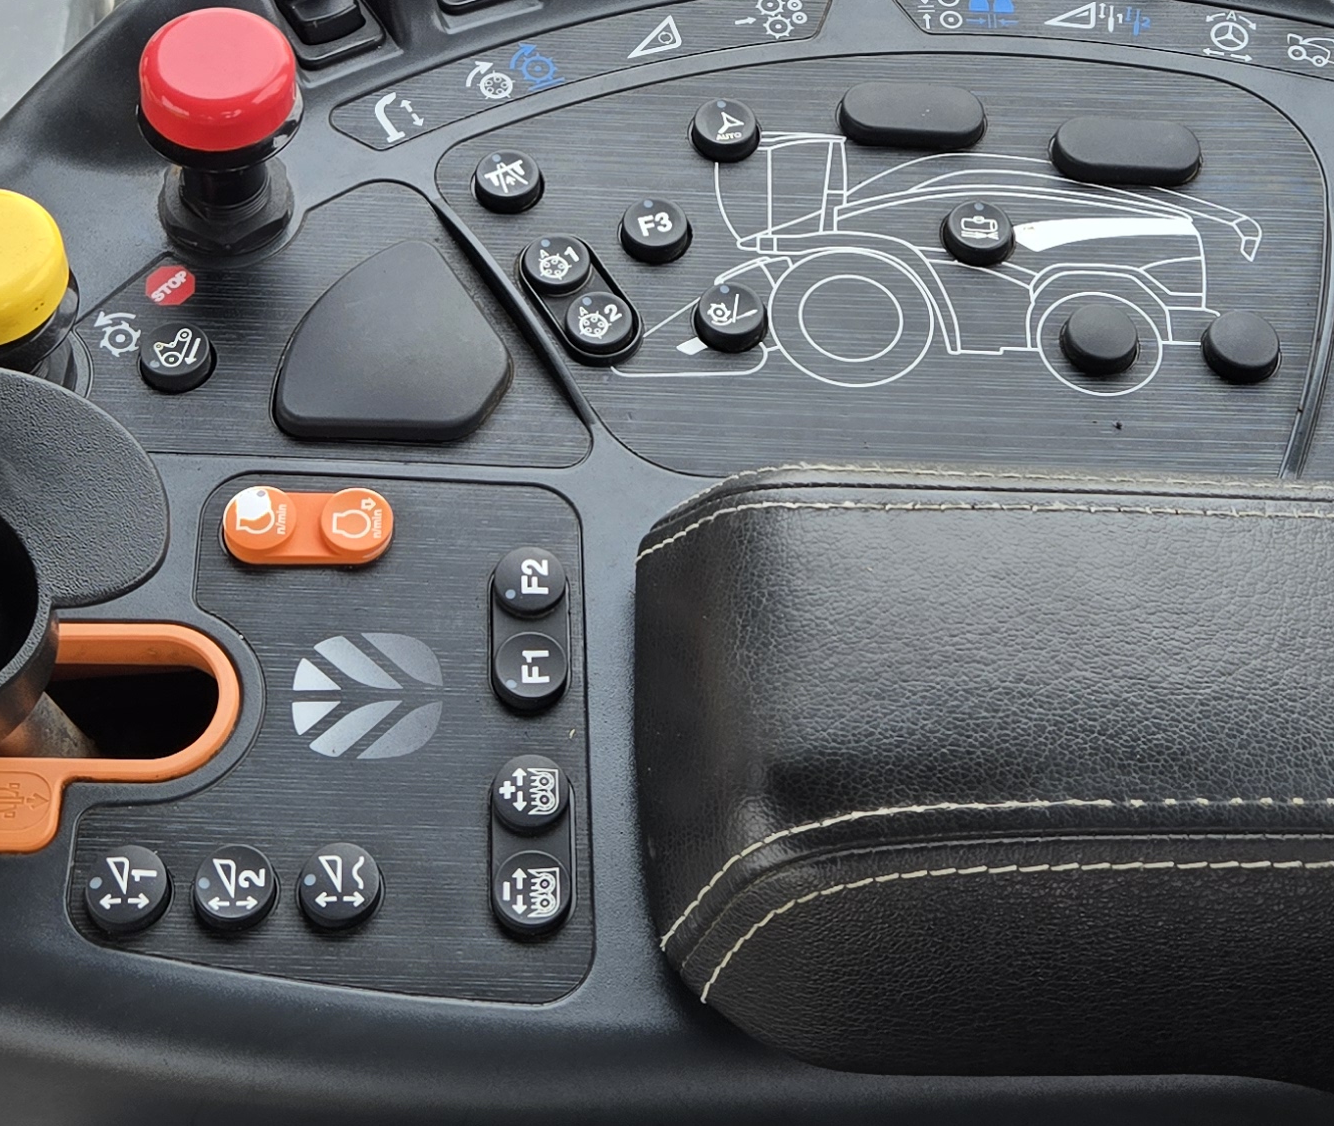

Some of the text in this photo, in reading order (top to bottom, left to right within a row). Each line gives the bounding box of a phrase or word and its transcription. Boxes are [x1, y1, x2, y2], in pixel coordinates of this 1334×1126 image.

[716, 131, 743, 141] AUTO
[637, 211, 673, 237] F3
[564, 246, 580, 263] 1
[151, 270, 187, 302] STOP
[603, 303, 623, 323] 2
[521, 558, 549, 595] F2
[521, 649, 550, 683] F1
[238, 867, 265, 888] 2
